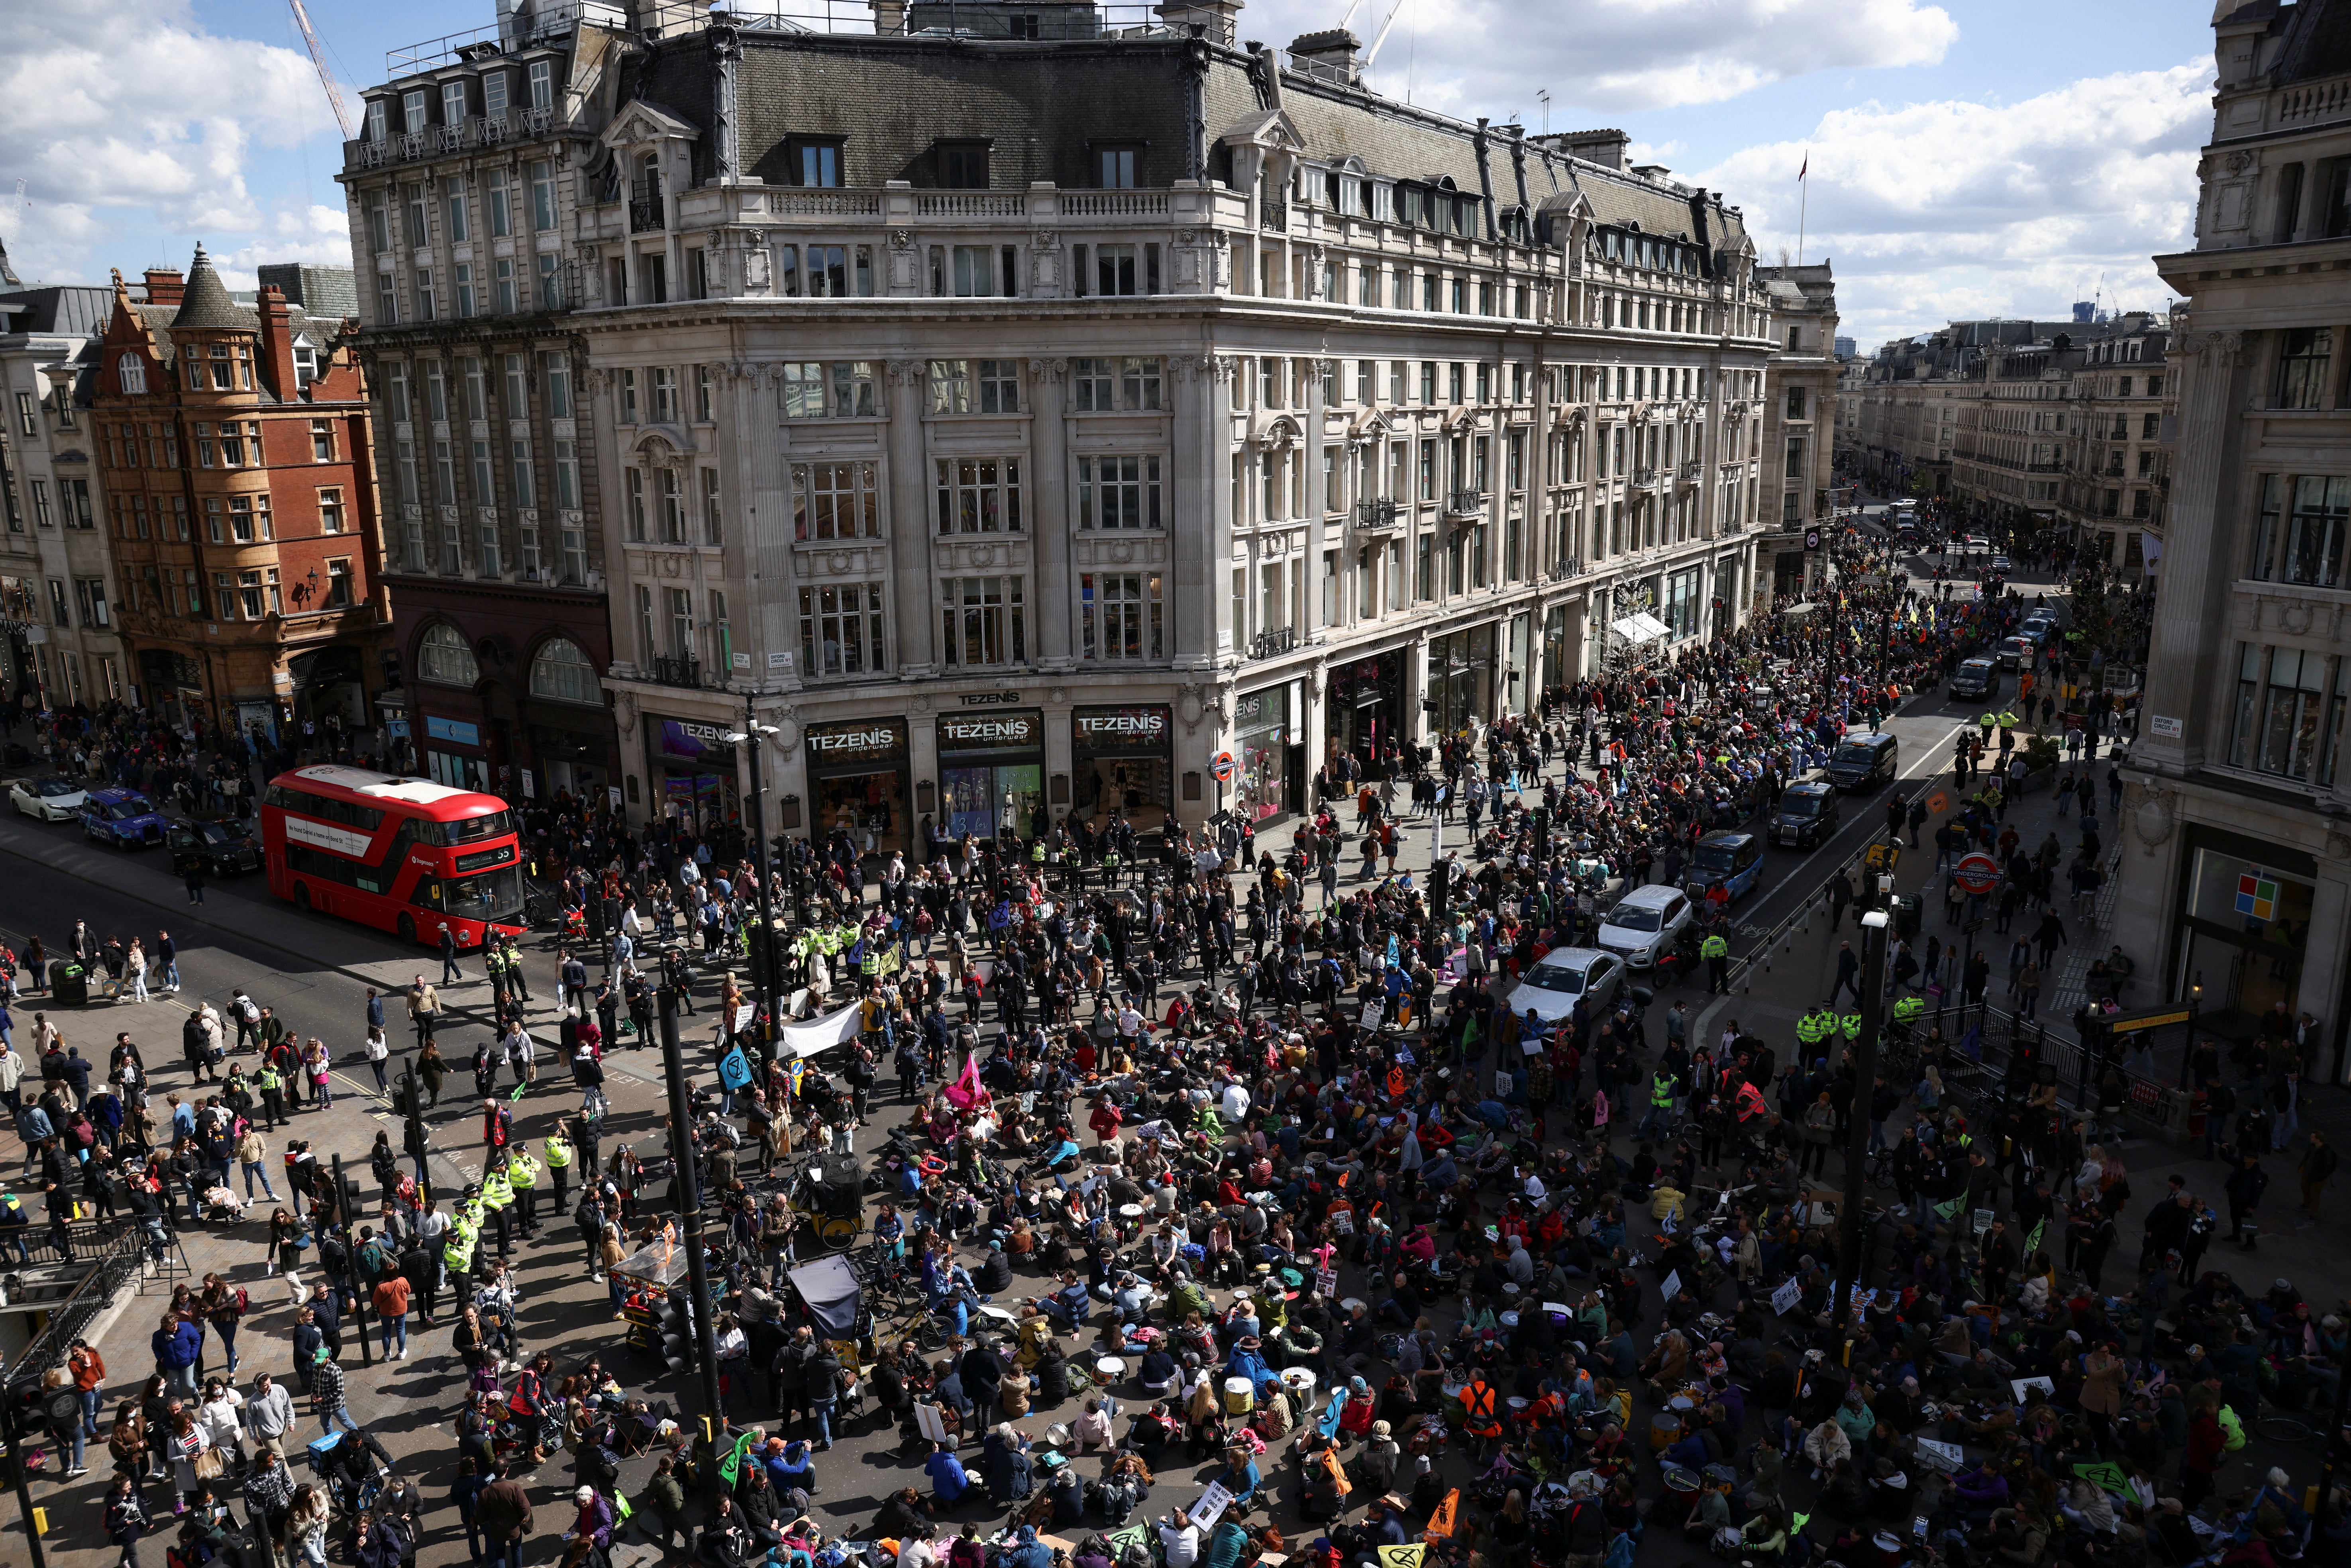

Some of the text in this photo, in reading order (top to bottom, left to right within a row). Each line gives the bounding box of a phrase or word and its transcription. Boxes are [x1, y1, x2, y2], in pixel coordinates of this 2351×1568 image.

[1369, 638, 1384, 649] KIKO
[1292, 662, 1306, 672] 266-270
[1235, 711, 1259, 721] underwear
[430, 724, 477, 738] CURRENCY EXCHANGE
[705, 740, 736, 748] underwear
[848, 743, 893, 752] underwear
[1214, 763, 1234, 771] UNDERGROUND
[957, 817, 989, 833] 3 for
[90, 825, 110, 840] cinch
[498, 848, 509, 859] 55
[416, 858, 434, 867] Stagecoach
[459, 856, 480, 865] Walthamstow
[1954, 870, 2000, 880] UNDERGROUND
[1361, 1022, 1377, 1030] MAJORITY
[603, 1071, 645, 1087] LEFT
[437, 1142, 467, 1163] LOOK
[1318, 1274, 1336, 1282] BYSTANDERS
[1776, 1293, 1785, 1311] FUTURE
[1782, 1291, 1788, 1303] MY
[196, 1464, 222, 1480] ZARA
[1221, 1490, 1229, 1498] HERE
[1208, 1499, 1217, 1509] CHILD
